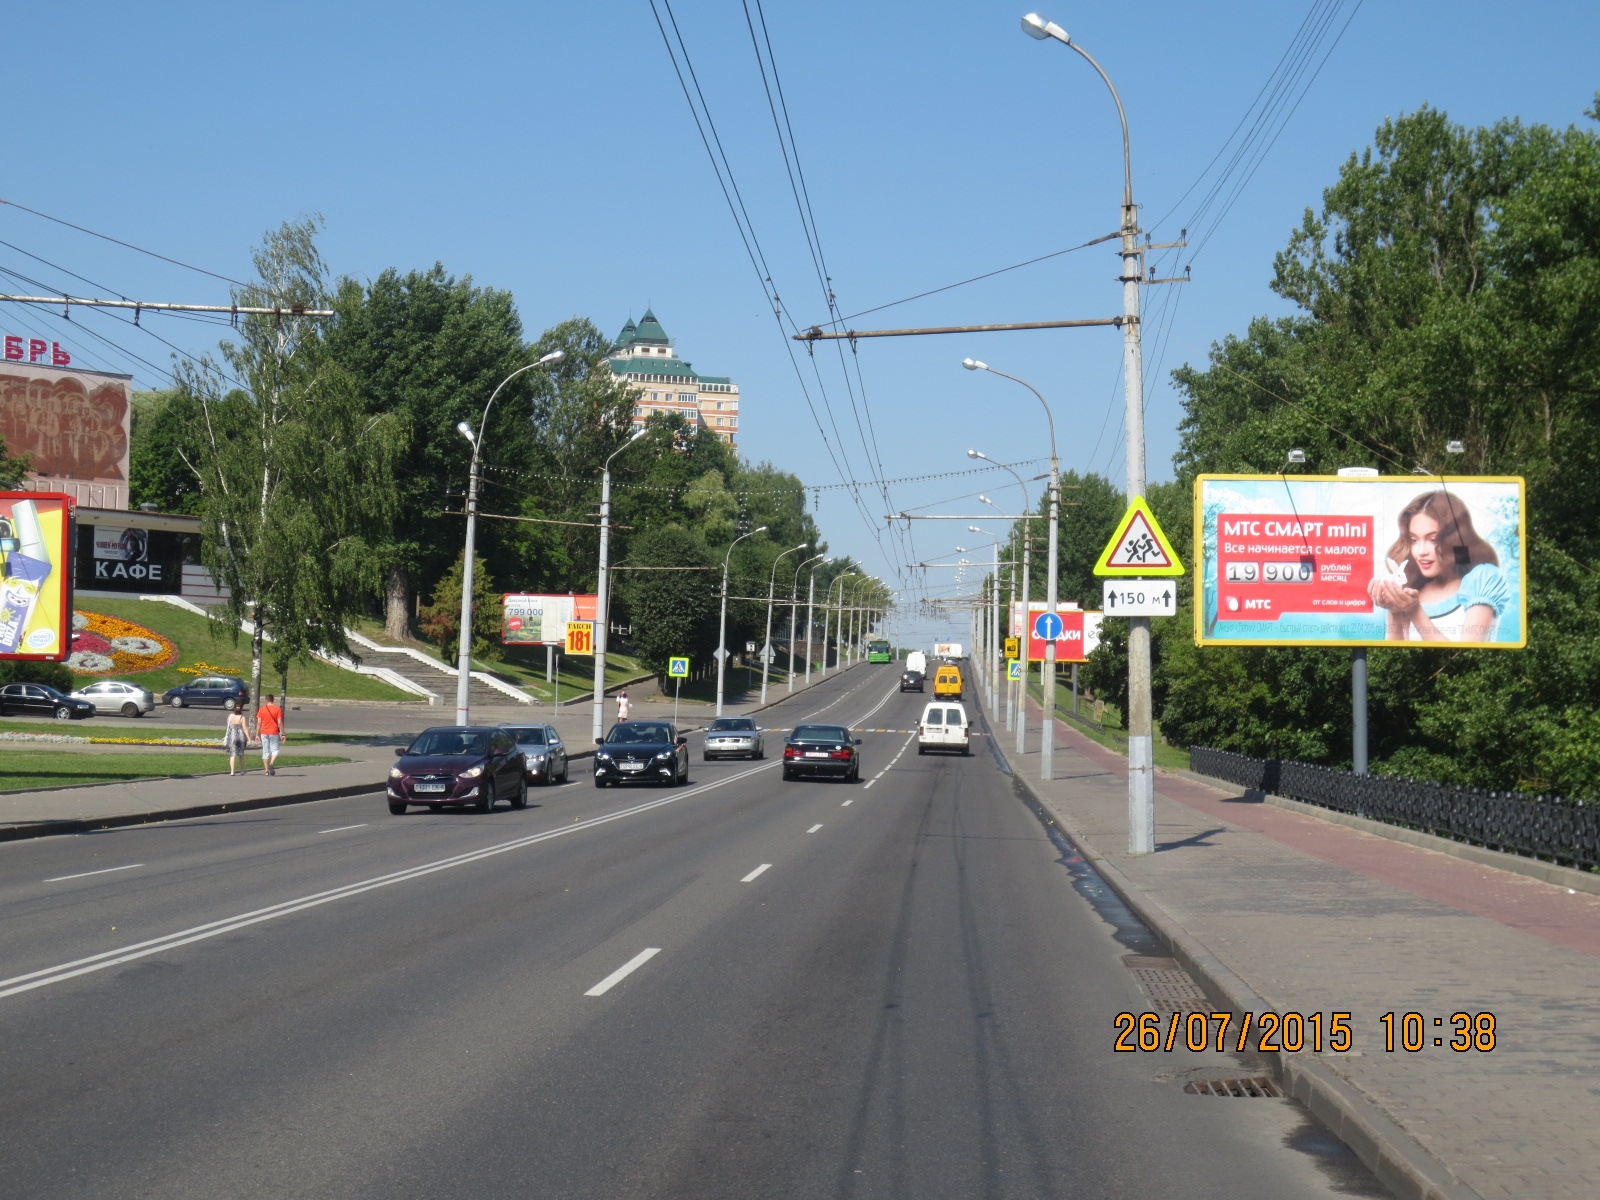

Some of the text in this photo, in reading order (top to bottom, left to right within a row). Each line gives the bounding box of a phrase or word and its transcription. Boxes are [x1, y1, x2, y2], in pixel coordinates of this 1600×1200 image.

[1224, 521, 1367, 538] МТС СМАРТ mini
[1224, 542, 1367, 555] Все начинается с малого
[95, 561, 162, 580] КАФЕ
[1228, 564, 1311, 581] 19 900
[1320, 563, 1352, 573] рублей
[1320, 574, 1347, 583] месяц
[1120, 592, 1161, 605] 150 м
[1245, 599, 1272, 610] МТС
[1344, 599, 1367, 607] цифре
[508, 608, 543, 616] 799 000
[568, 630, 591, 651] 181
[1031, 629, 1081, 642] СДКИ
